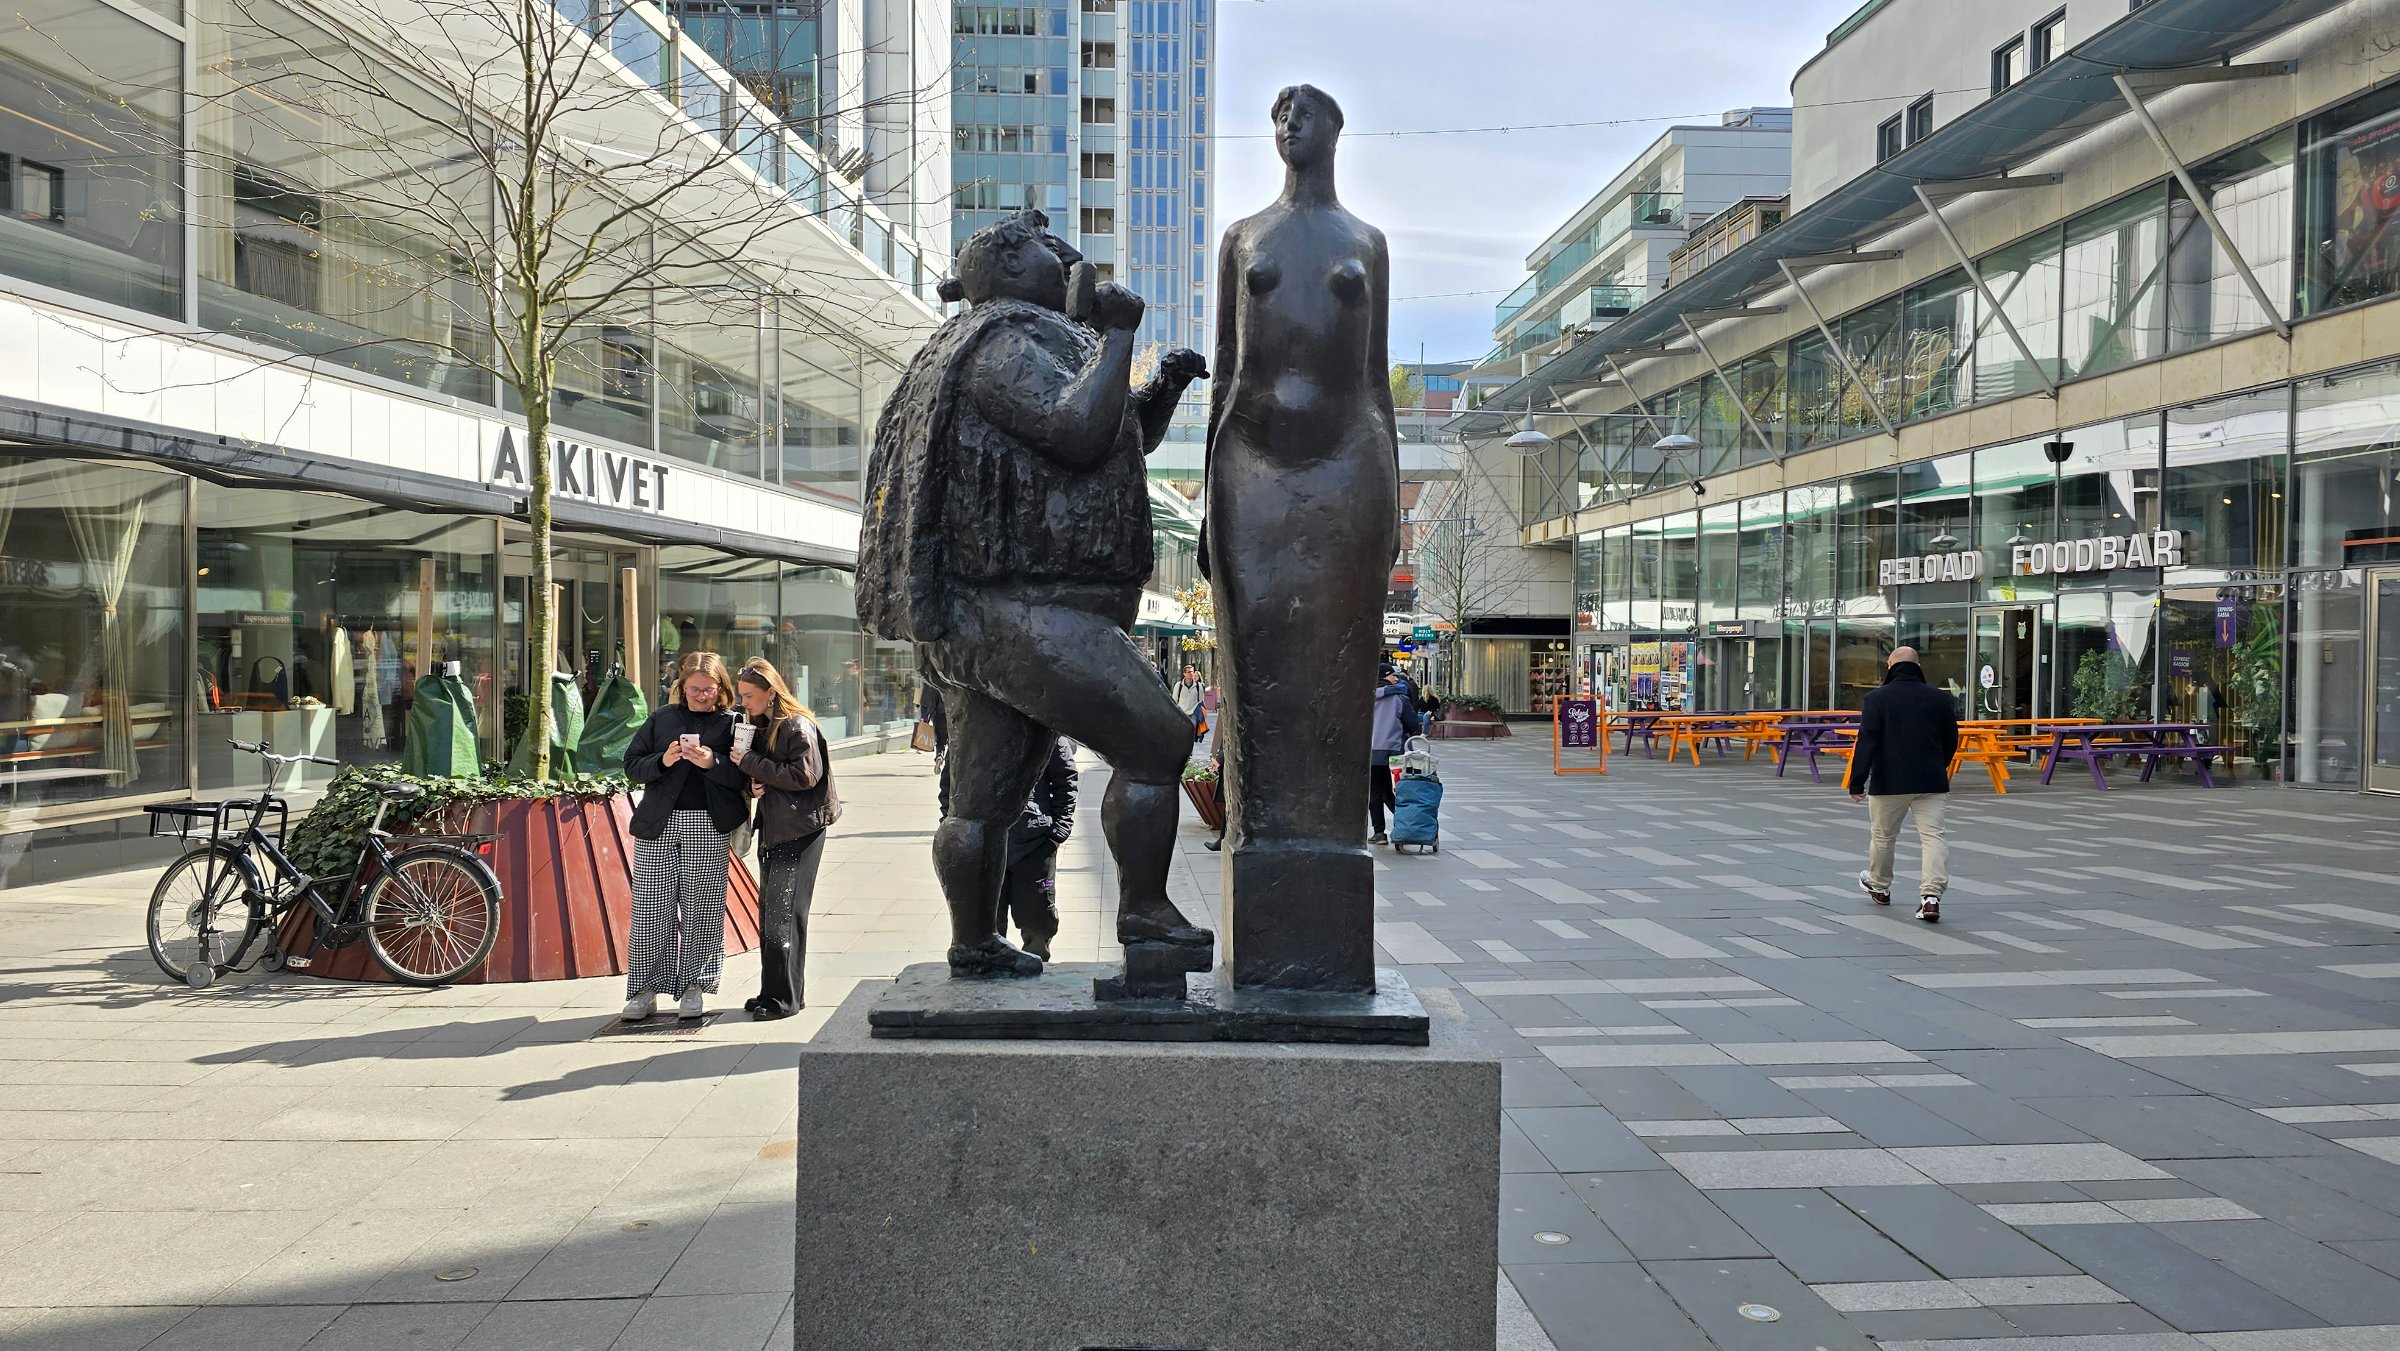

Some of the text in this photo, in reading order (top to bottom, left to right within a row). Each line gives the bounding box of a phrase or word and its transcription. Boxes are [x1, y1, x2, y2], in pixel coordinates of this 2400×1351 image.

[494, 426, 668, 511] AKIVET
[1879, 529, 2182, 586] RELOAD FOODBAR
